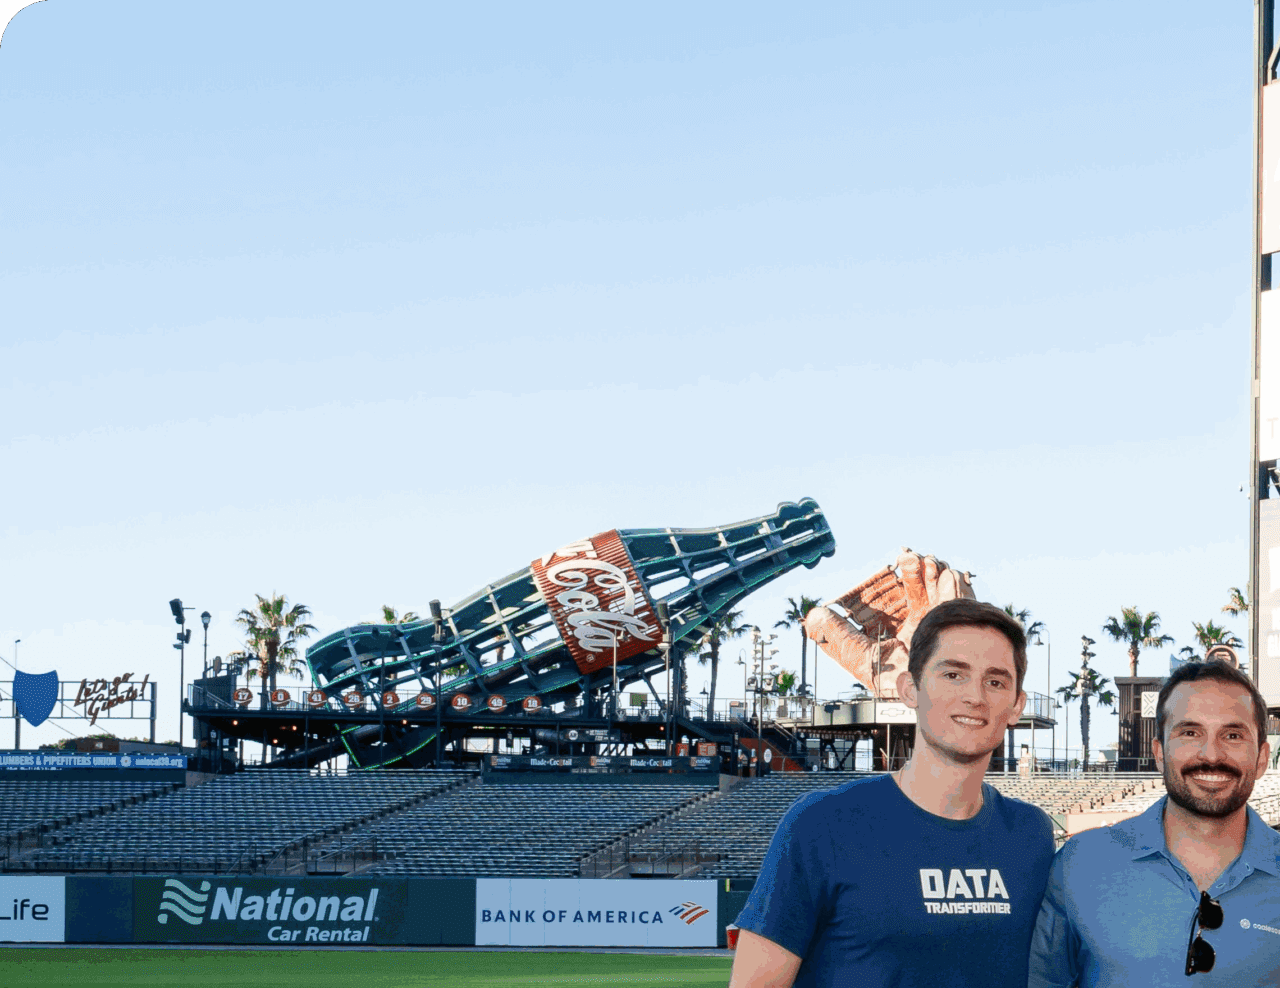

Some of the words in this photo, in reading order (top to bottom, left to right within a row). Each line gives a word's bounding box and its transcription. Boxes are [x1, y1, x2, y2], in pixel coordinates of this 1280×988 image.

[0, 755, 34, 766] LUMBERS
[919, 868, 1010, 900] DATA
[210, 886, 380, 922] National
[923, 901, 1012, 915] TRANSFORMER
[481, 909, 536, 923] BANK
[542, 909, 568, 923] OF
[572, 910, 664, 925] AMERICA
[266, 925, 302, 943] Car
[304, 925, 371, 942] Rental
